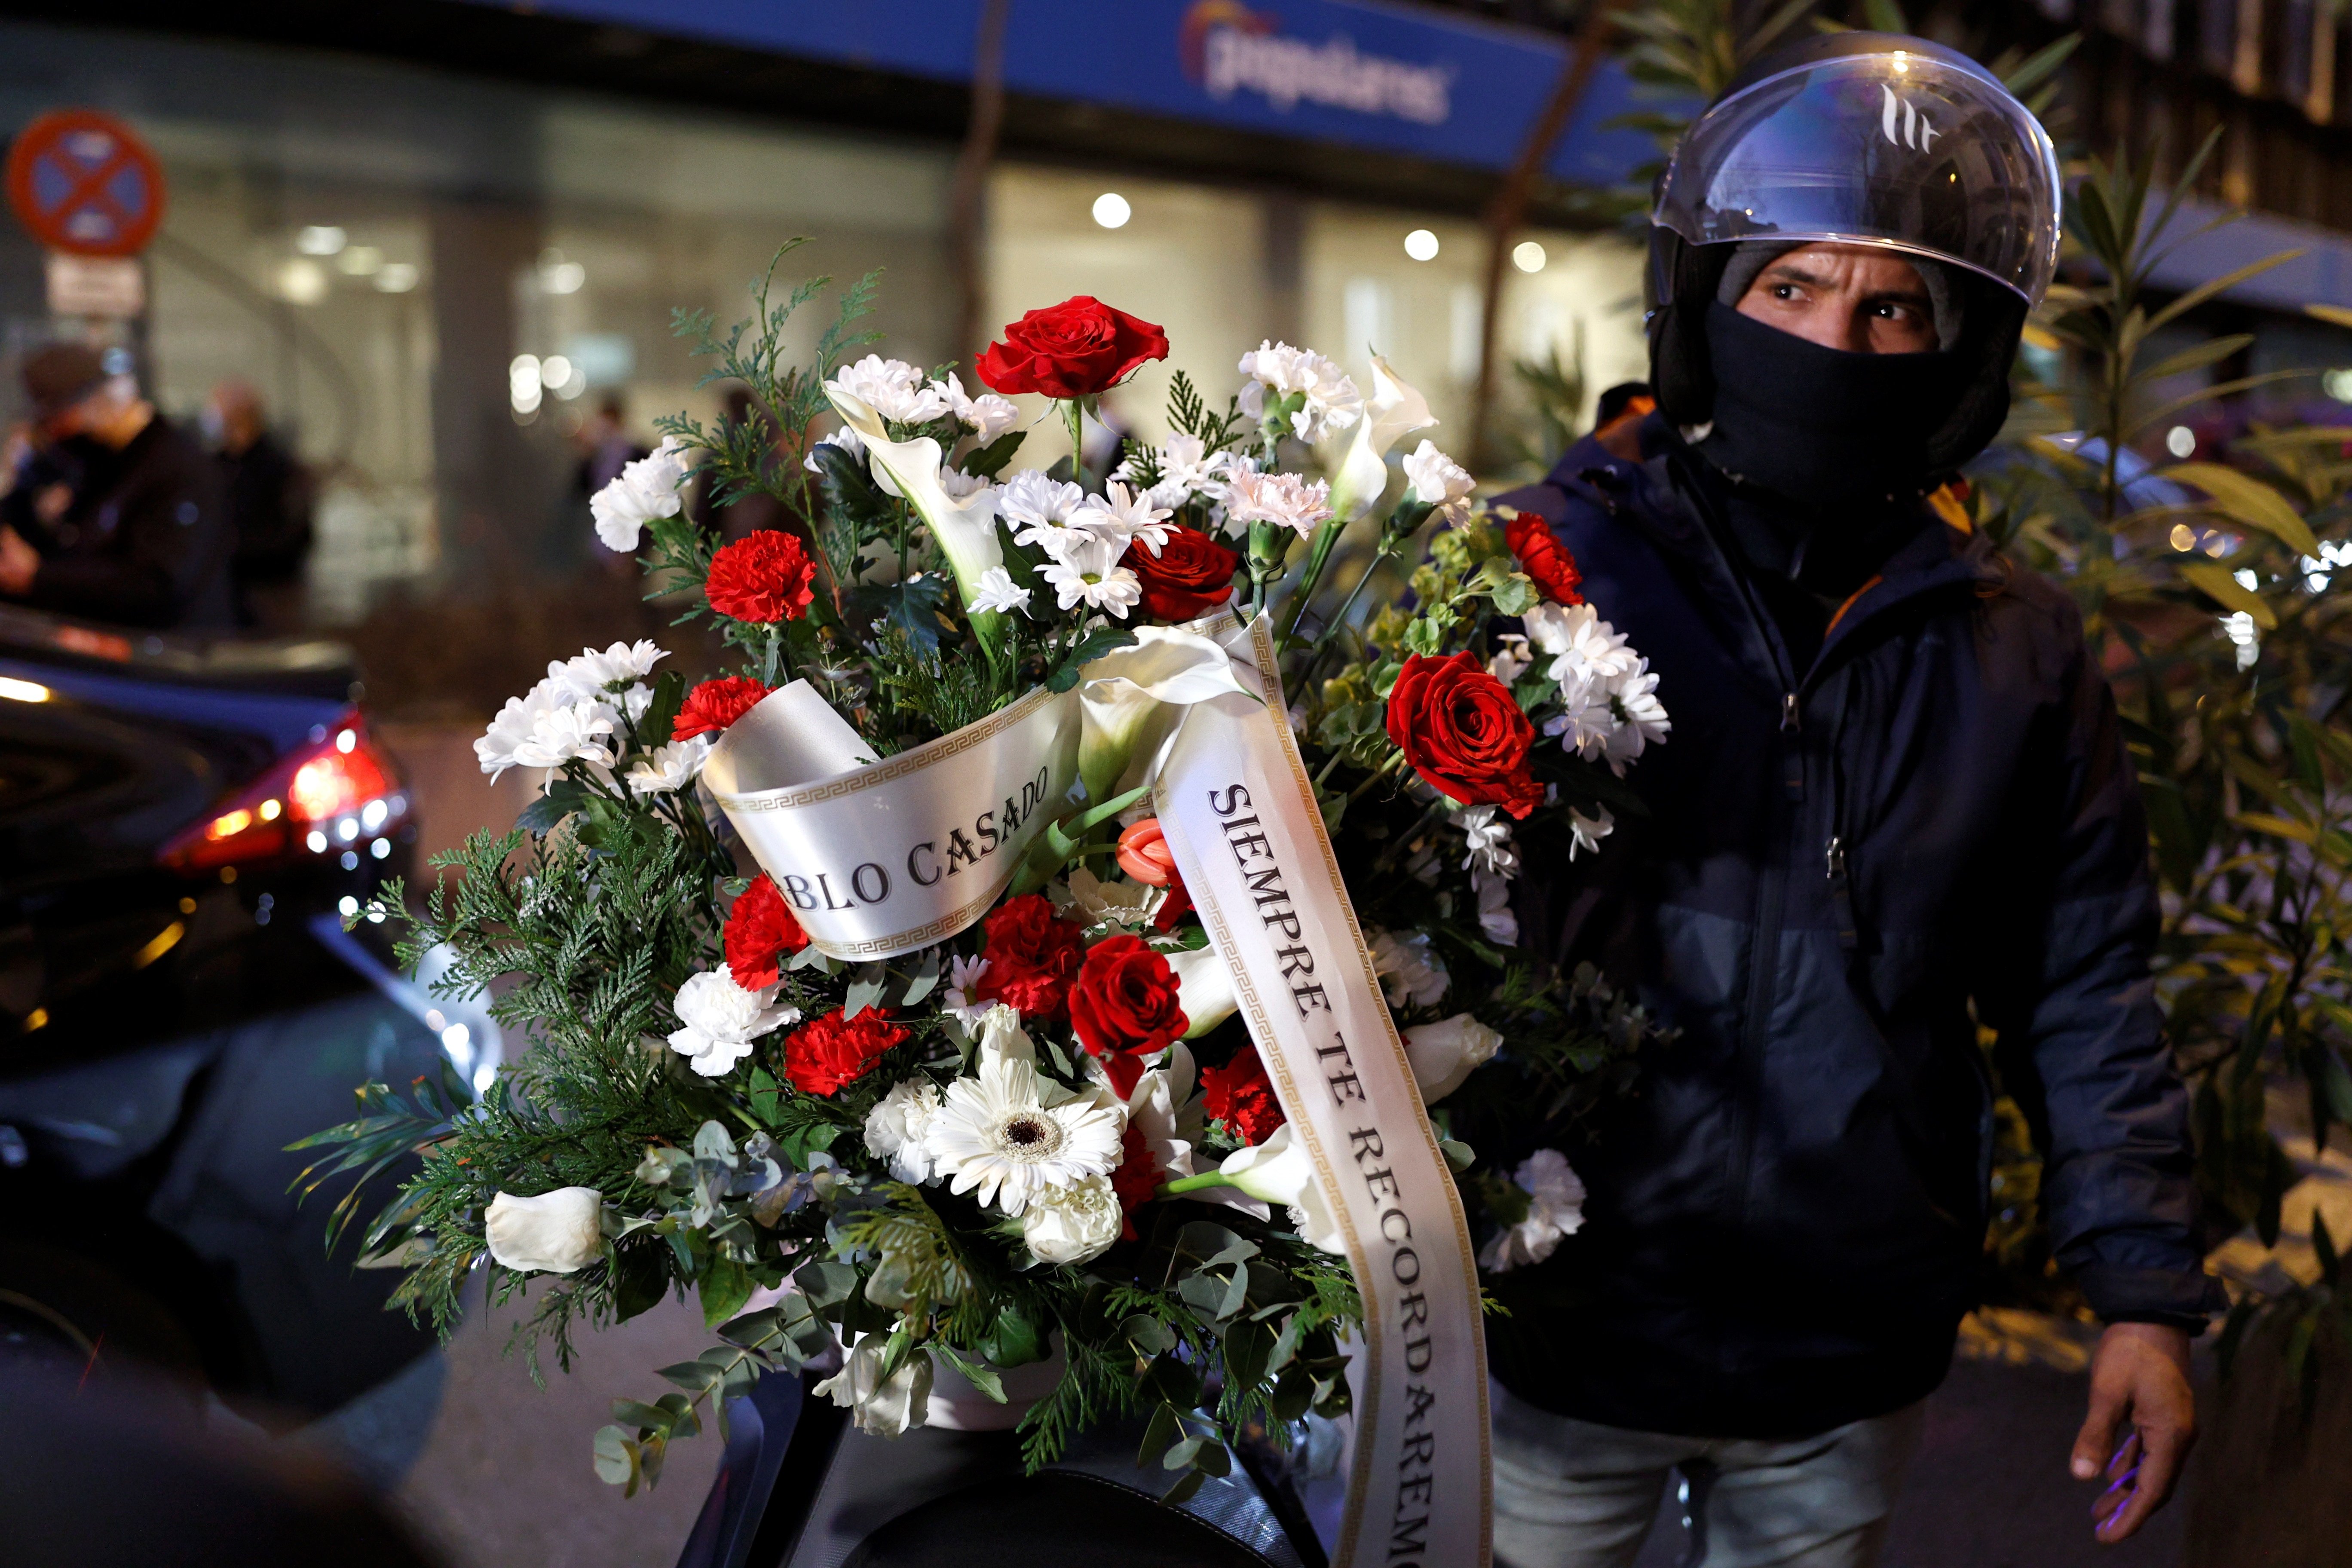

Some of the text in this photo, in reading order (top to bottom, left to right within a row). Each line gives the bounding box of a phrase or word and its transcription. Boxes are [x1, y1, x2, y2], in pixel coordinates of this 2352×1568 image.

[907, 766, 1048, 887] CASADO
[1207, 783, 1436, 1568] SIEMPRE TE RECORDAREM
